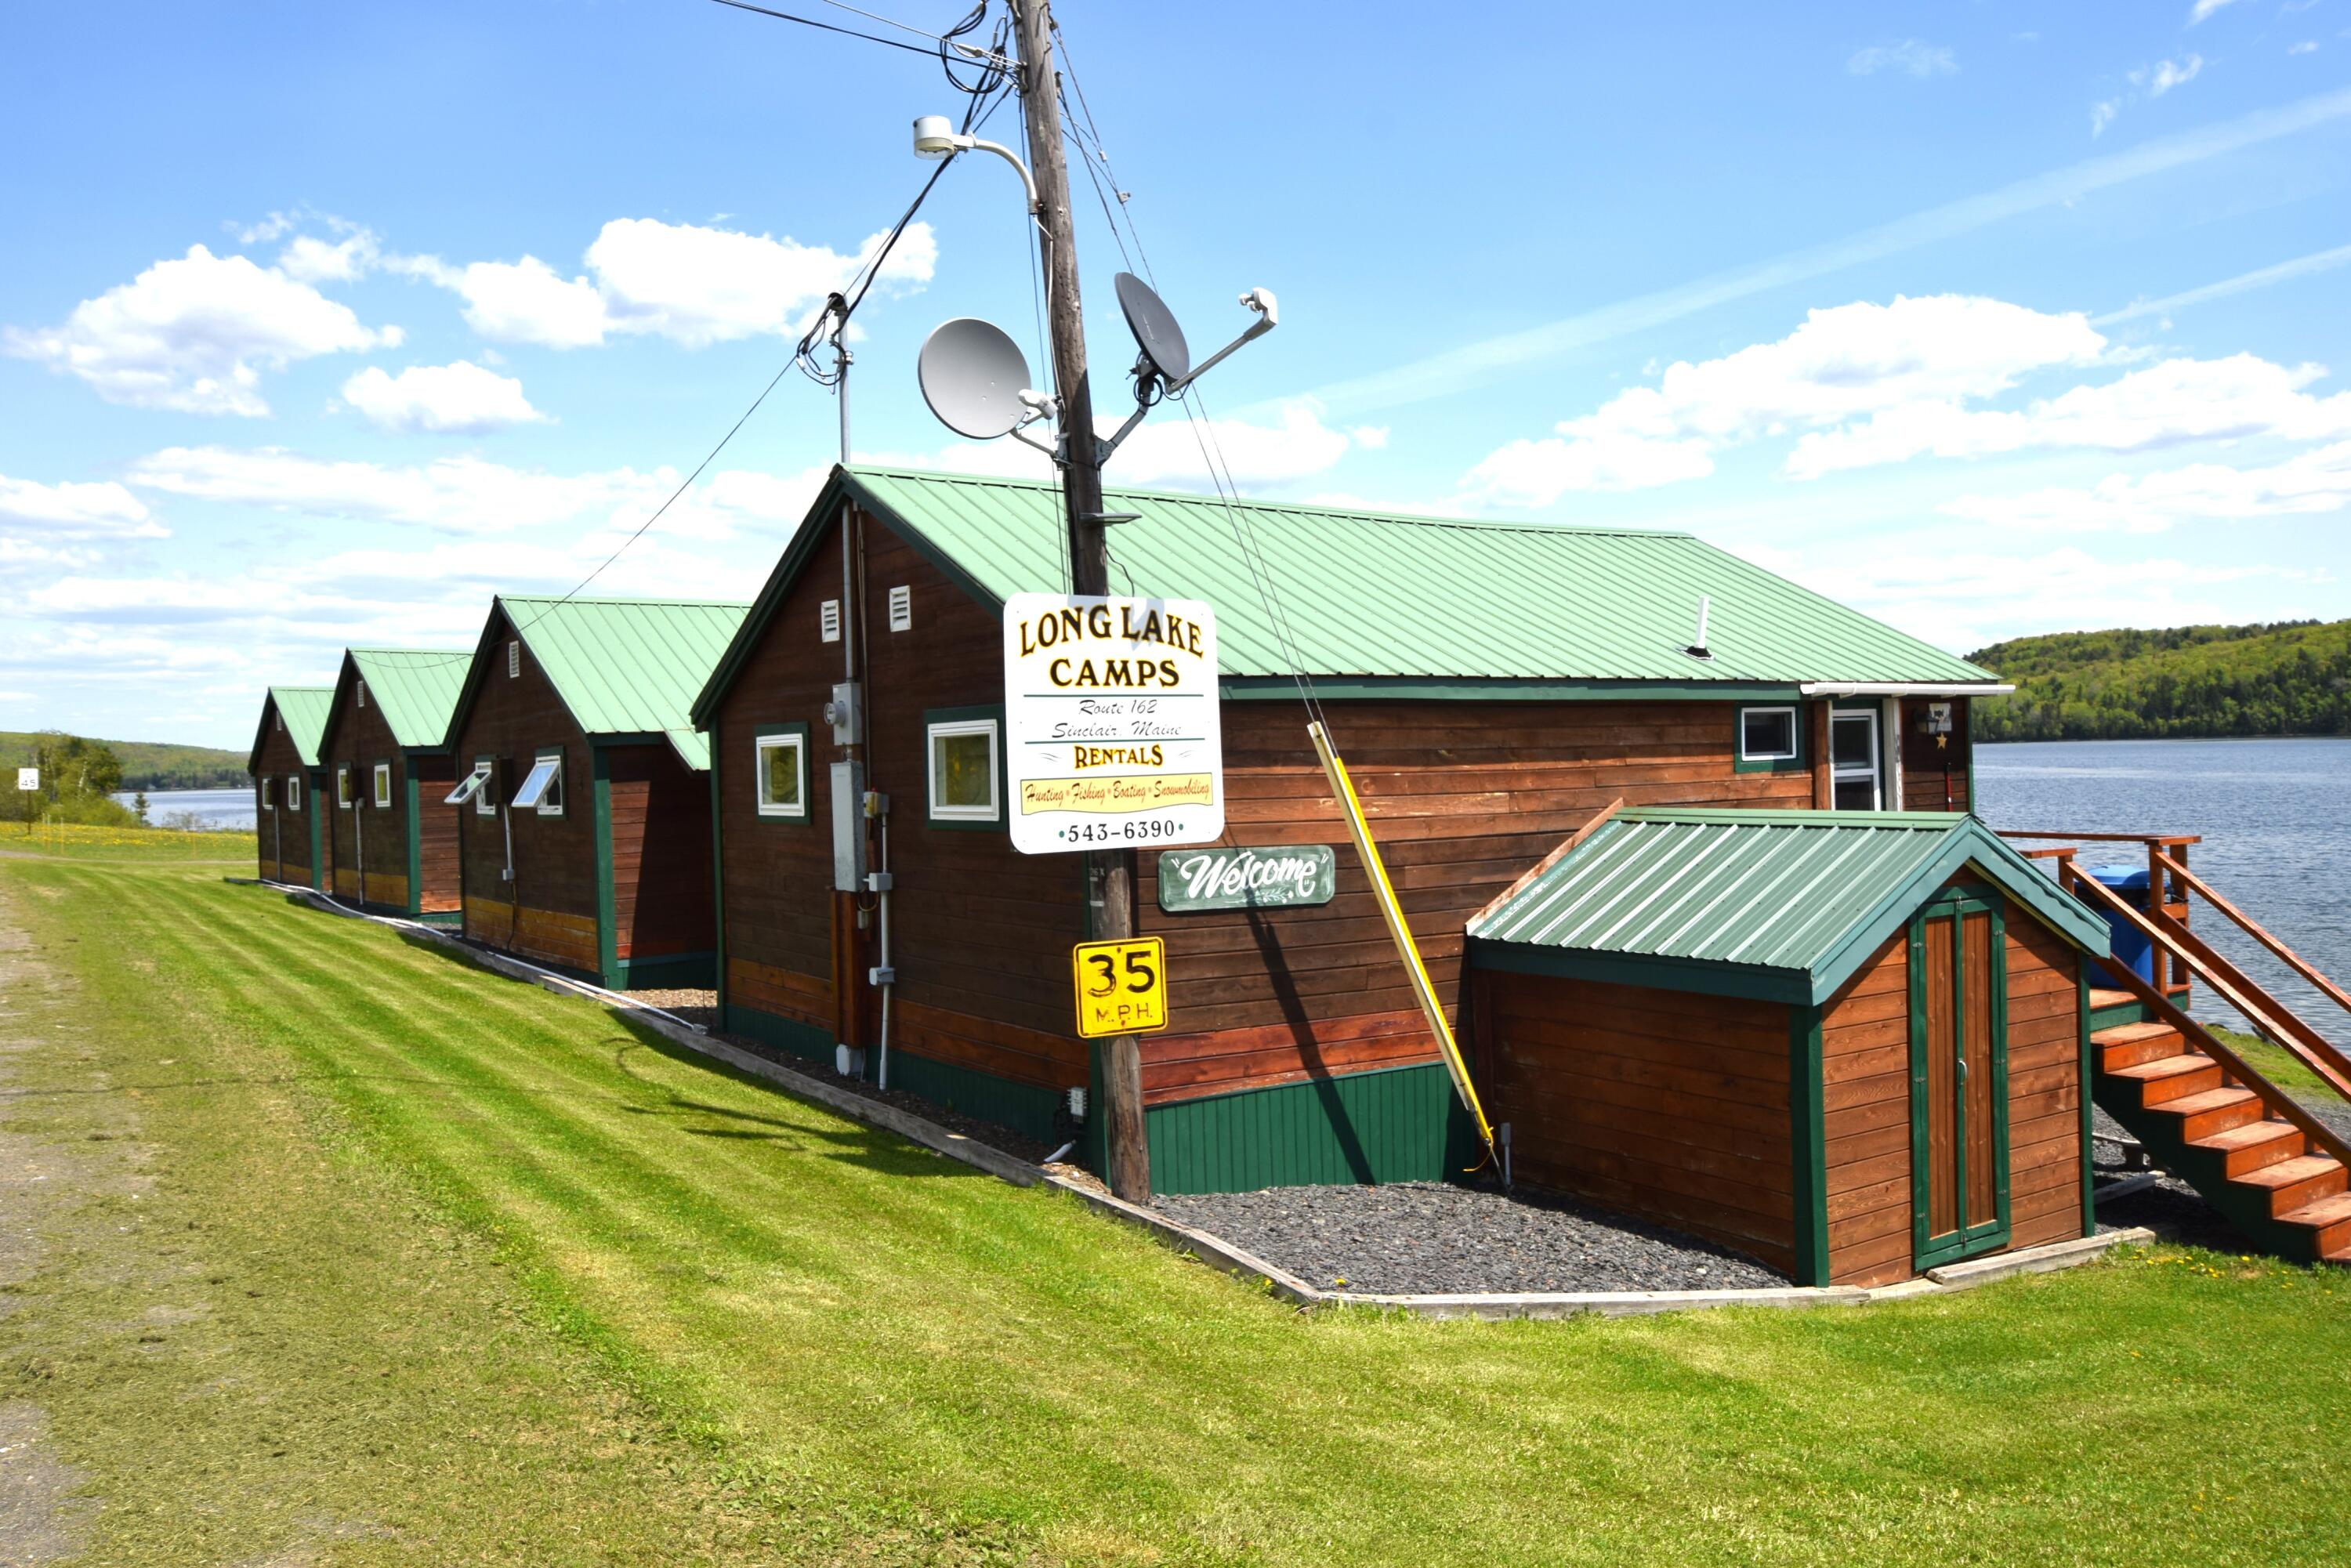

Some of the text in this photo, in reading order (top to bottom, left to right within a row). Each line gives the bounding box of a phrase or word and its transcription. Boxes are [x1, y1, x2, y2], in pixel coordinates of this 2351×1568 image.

[1020, 604, 1204, 659] LONG LAKE
[1049, 657, 1180, 687] CAMPS
[1079, 699, 1157, 715] Route 162
[1131, 720, 1182, 737] Maine
[1074, 744, 1164, 769] RENTALS
[1025, 777, 1210, 808] Hunting Fishing Boating Snowmobiling
[1067, 820, 1175, 842] 543-6390
[1180, 851, 1317, 899] Welcome
[1087, 950, 1156, 998] 35
